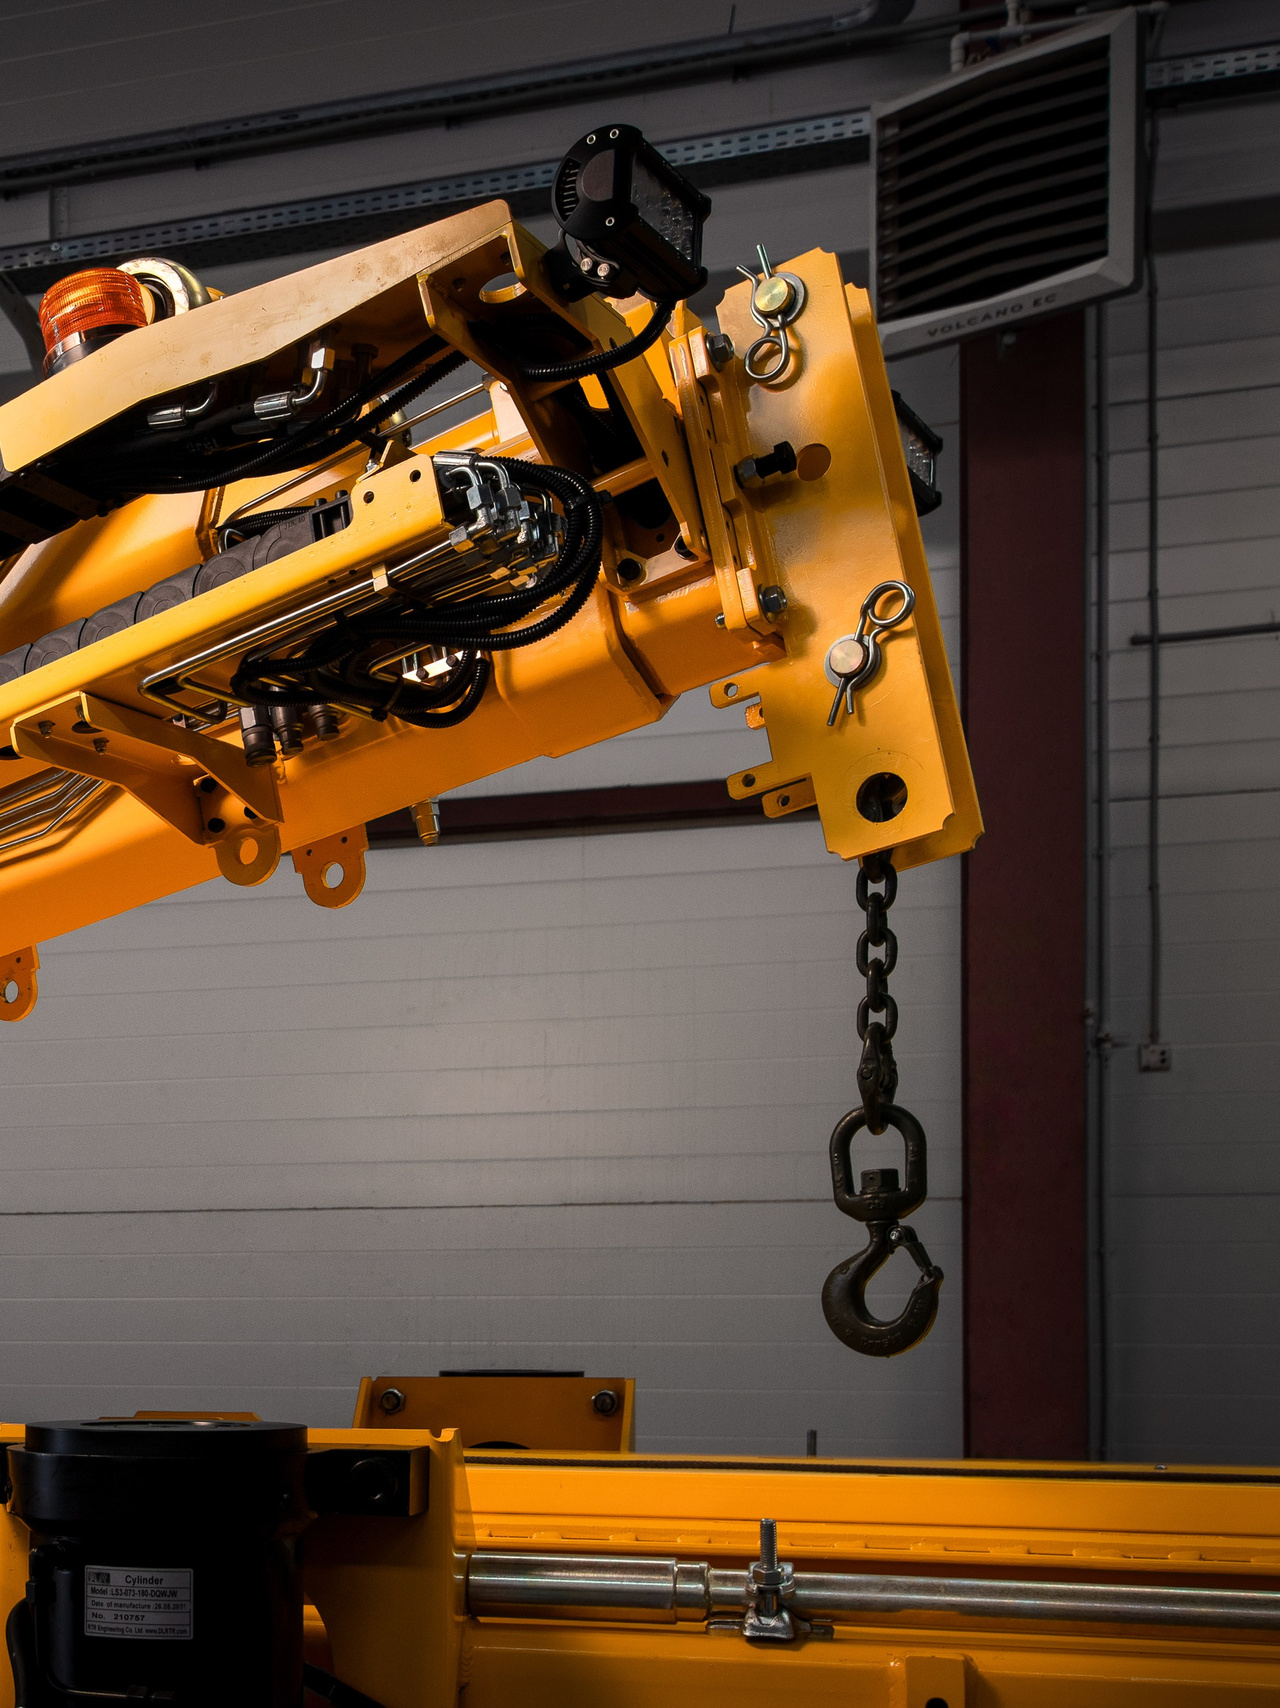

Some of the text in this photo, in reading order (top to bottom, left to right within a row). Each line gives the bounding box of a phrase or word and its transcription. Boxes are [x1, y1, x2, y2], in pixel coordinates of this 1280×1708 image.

[927, 293, 1057, 337] VOLCANO EC
[125, 1574, 164, 1586] Cylinder
[90, 1586, 108, 1595] Model
[91, 1599, 104, 1607] Date
[114, 1602, 151, 1610] manufacture
[91, 1612, 106, 1620] No.
[97, 1624, 125, 1634] Engineering
